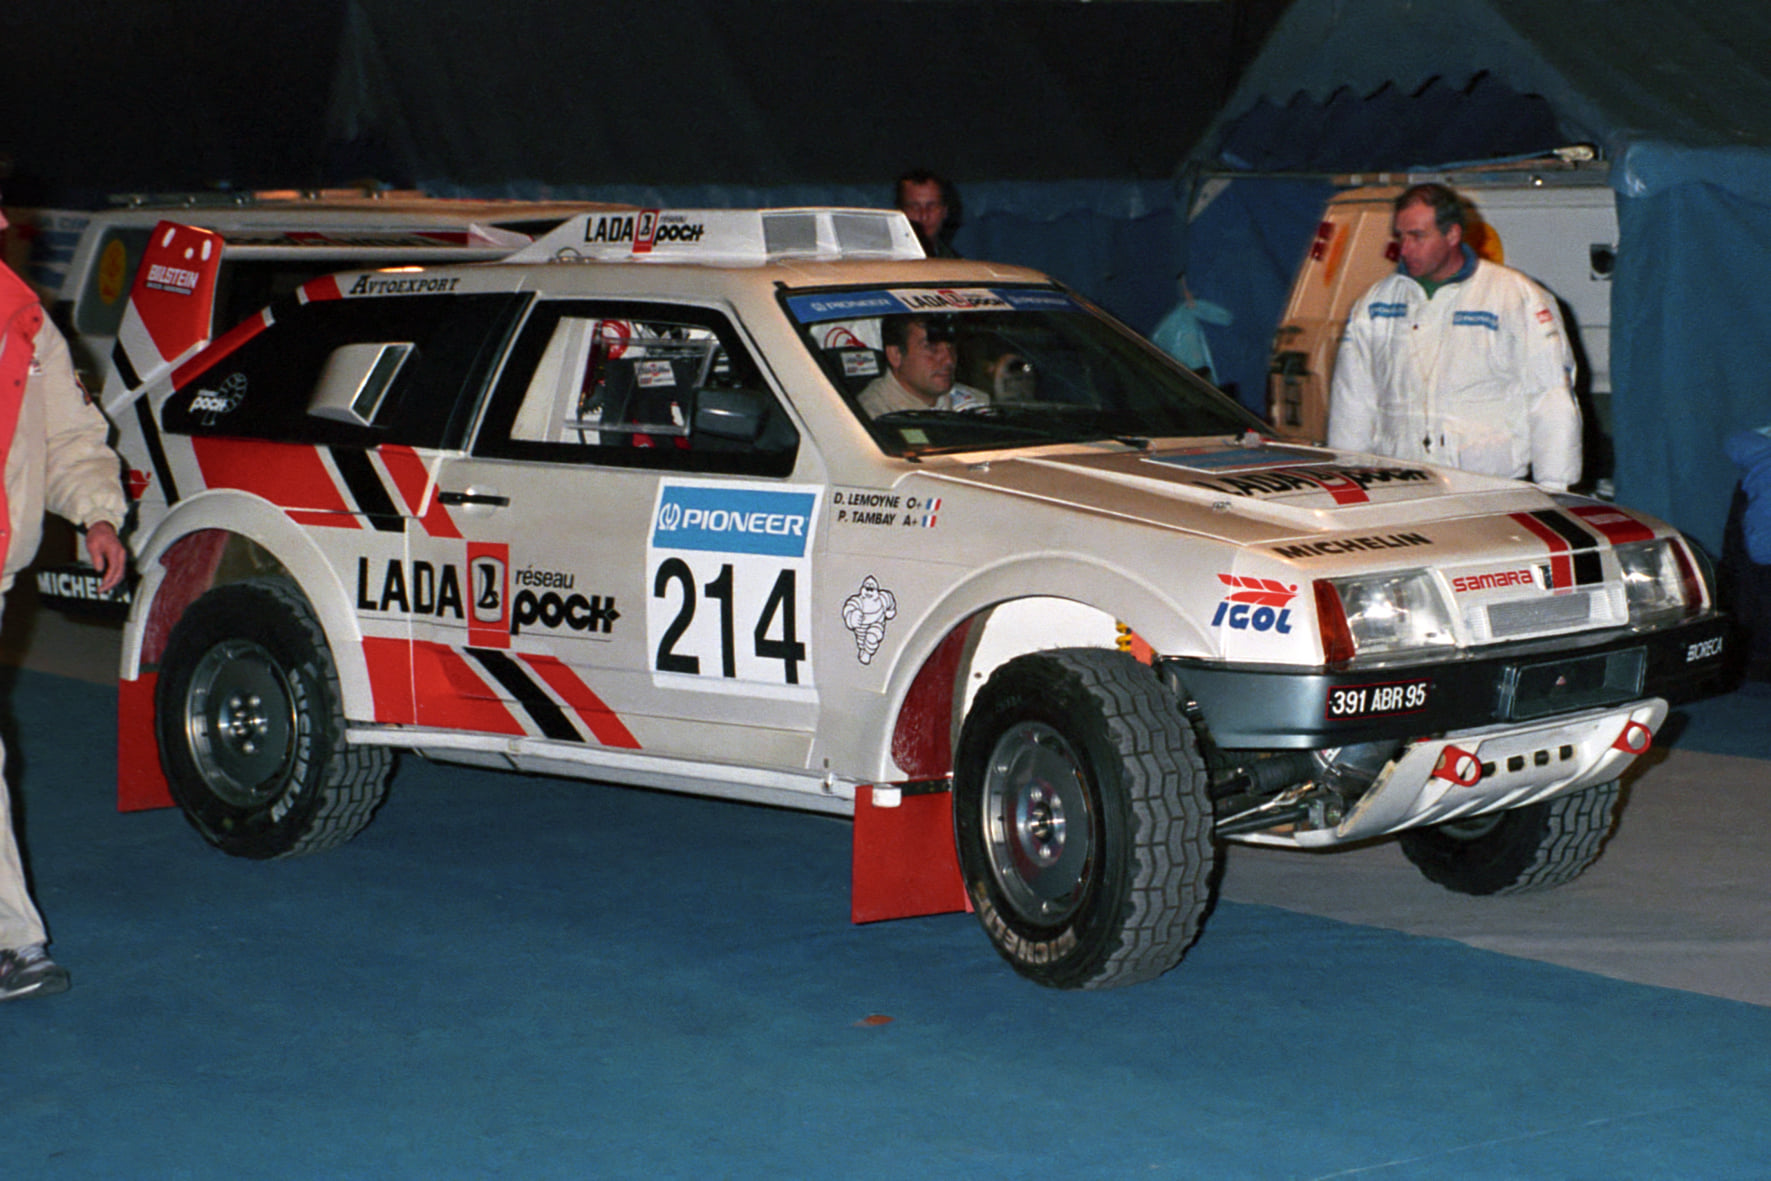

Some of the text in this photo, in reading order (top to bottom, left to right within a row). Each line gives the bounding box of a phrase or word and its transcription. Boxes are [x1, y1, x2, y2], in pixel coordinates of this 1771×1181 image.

[584, 216, 633, 242] LADA
[147, 264, 199, 289] BILSTEIN
[902, 294, 951, 308] LADA
[1193, 470, 1319, 497] LADA
[833, 492, 845, 505] D.
[847, 494, 901, 509] LEMOYNE
[682, 509, 805, 537] PIONEER
[837, 510, 848, 522] P.
[852, 511, 896, 526] TAMBAY
[1271, 532, 1433, 559] MICHELIN
[356, 556, 465, 620] LADA
[515, 564, 574, 589] réseau
[653, 556, 806, 685] 214
[1211, 602, 1293, 634] IGOL
[1331, 682, 1428, 714] 391 ABR 95
